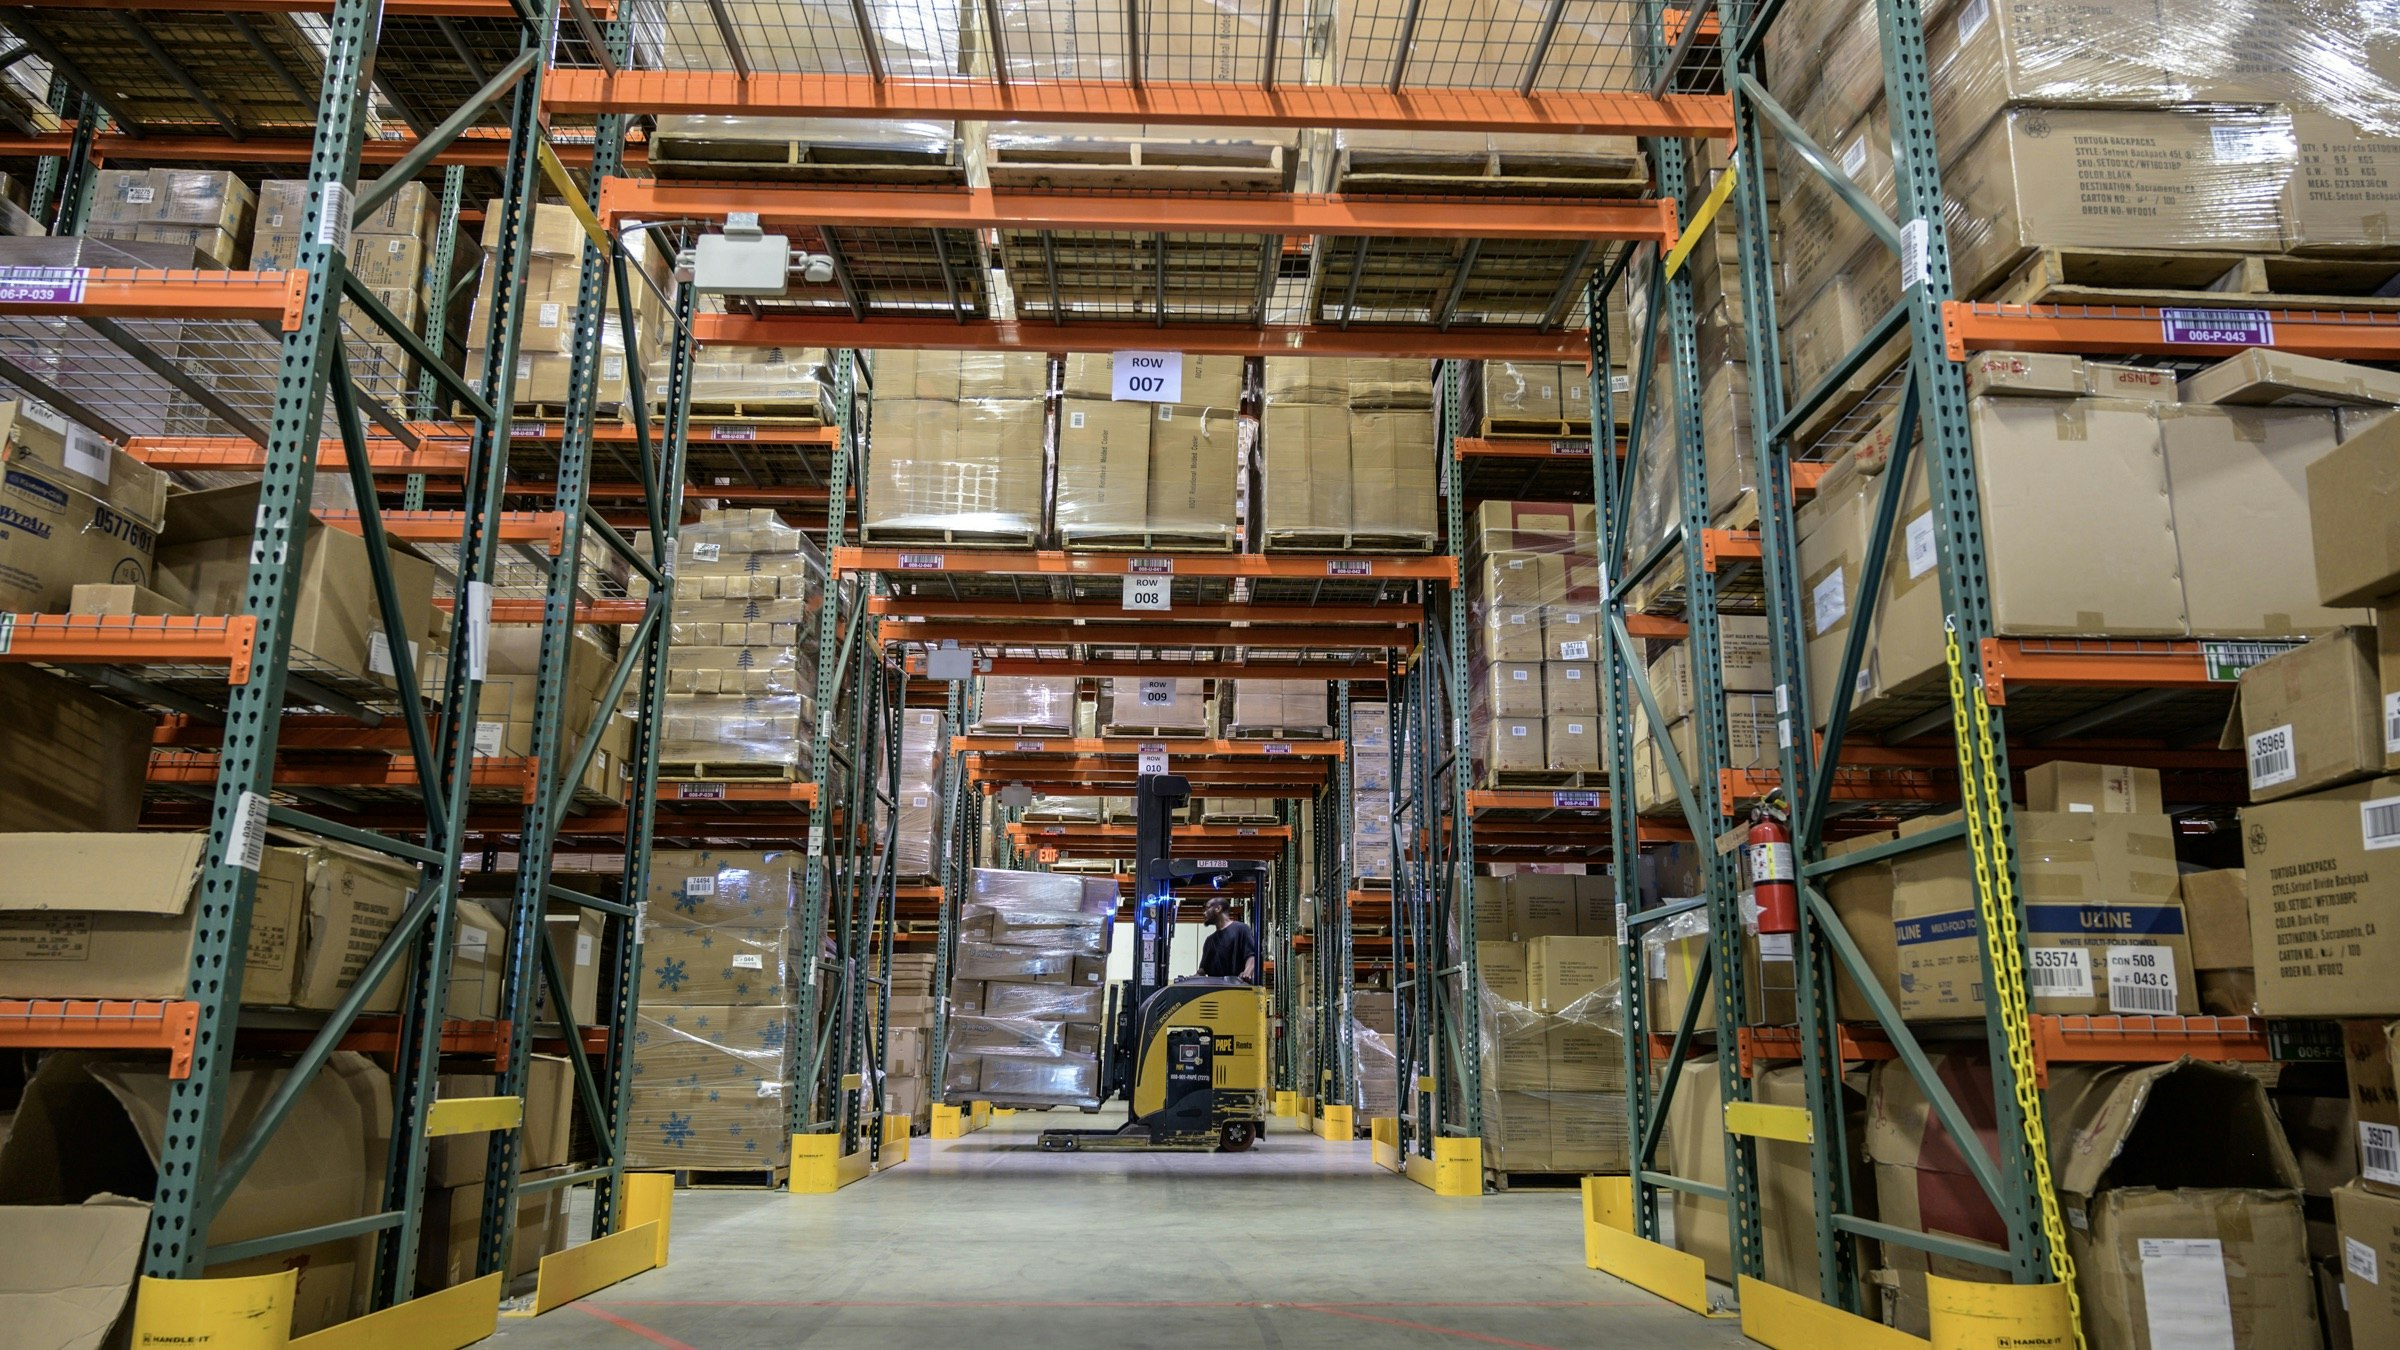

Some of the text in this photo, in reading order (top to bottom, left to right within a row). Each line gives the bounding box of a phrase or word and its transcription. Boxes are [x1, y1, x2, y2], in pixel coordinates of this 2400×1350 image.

[2074, 136, 2156, 146] TORTUGA BACKPACKS
[2323, 144, 2328, 152] 5
[2131, 150, 2167, 159] Backpack
[2358, 156, 2373, 164] KGS
[2361, 168, 2376, 176] KGS
[2081, 194, 2112, 203] CARTON
[2082, 206, 2109, 215] ORDER
[2189, 331, 2246, 341] 006-P-043
[1132, 357, 1164, 368] ROW
[1129, 376, 1164, 392] 007
[1101, 429, 1109, 445] Cooler
[95, 507, 137, 546] 05776
[1136, 579, 1158, 587] ROW
[1134, 592, 1159, 604] 008
[1148, 692, 1168, 701] 009
[2256, 732, 2285, 756] 35969
[1146, 764, 1162, 772] 010
[242, 820, 252, 838] 039
[248, 796, 257, 817] GOH
[1039, 850, 1056, 862] EXIT
[1199, 860, 1227, 868] UF1788
[2270, 859, 2337, 880] TORTUGA BACKPACKS
[2314, 875, 2334, 890] Divide
[2335, 871, 2369, 888] Backpack
[2080, 912, 2132, 928] ULINE
[2298, 914, 2313, 927] Dark
[2314, 913, 2329, 926] Grey
[1931, 921, 1965, 934] MULTI-FOLD
[2366, 924, 2376, 936] CA
[2059, 938, 2158, 947] WHITE MULTI-FOLD TOWELS
[2035, 951, 2078, 968] 53574
[2112, 954, 2155, 967] CON 508
[2279, 950, 2302, 961] CARTON
[2280, 966, 2301, 978] ORDER
[2133, 973, 2156, 986] 043
[2160, 973, 2169, 986] C
[1160, 1002, 1181, 1023] POWER
[2368, 1127, 2393, 1148] 35977
[2013, 1338, 2051, 1346] HANDLE
